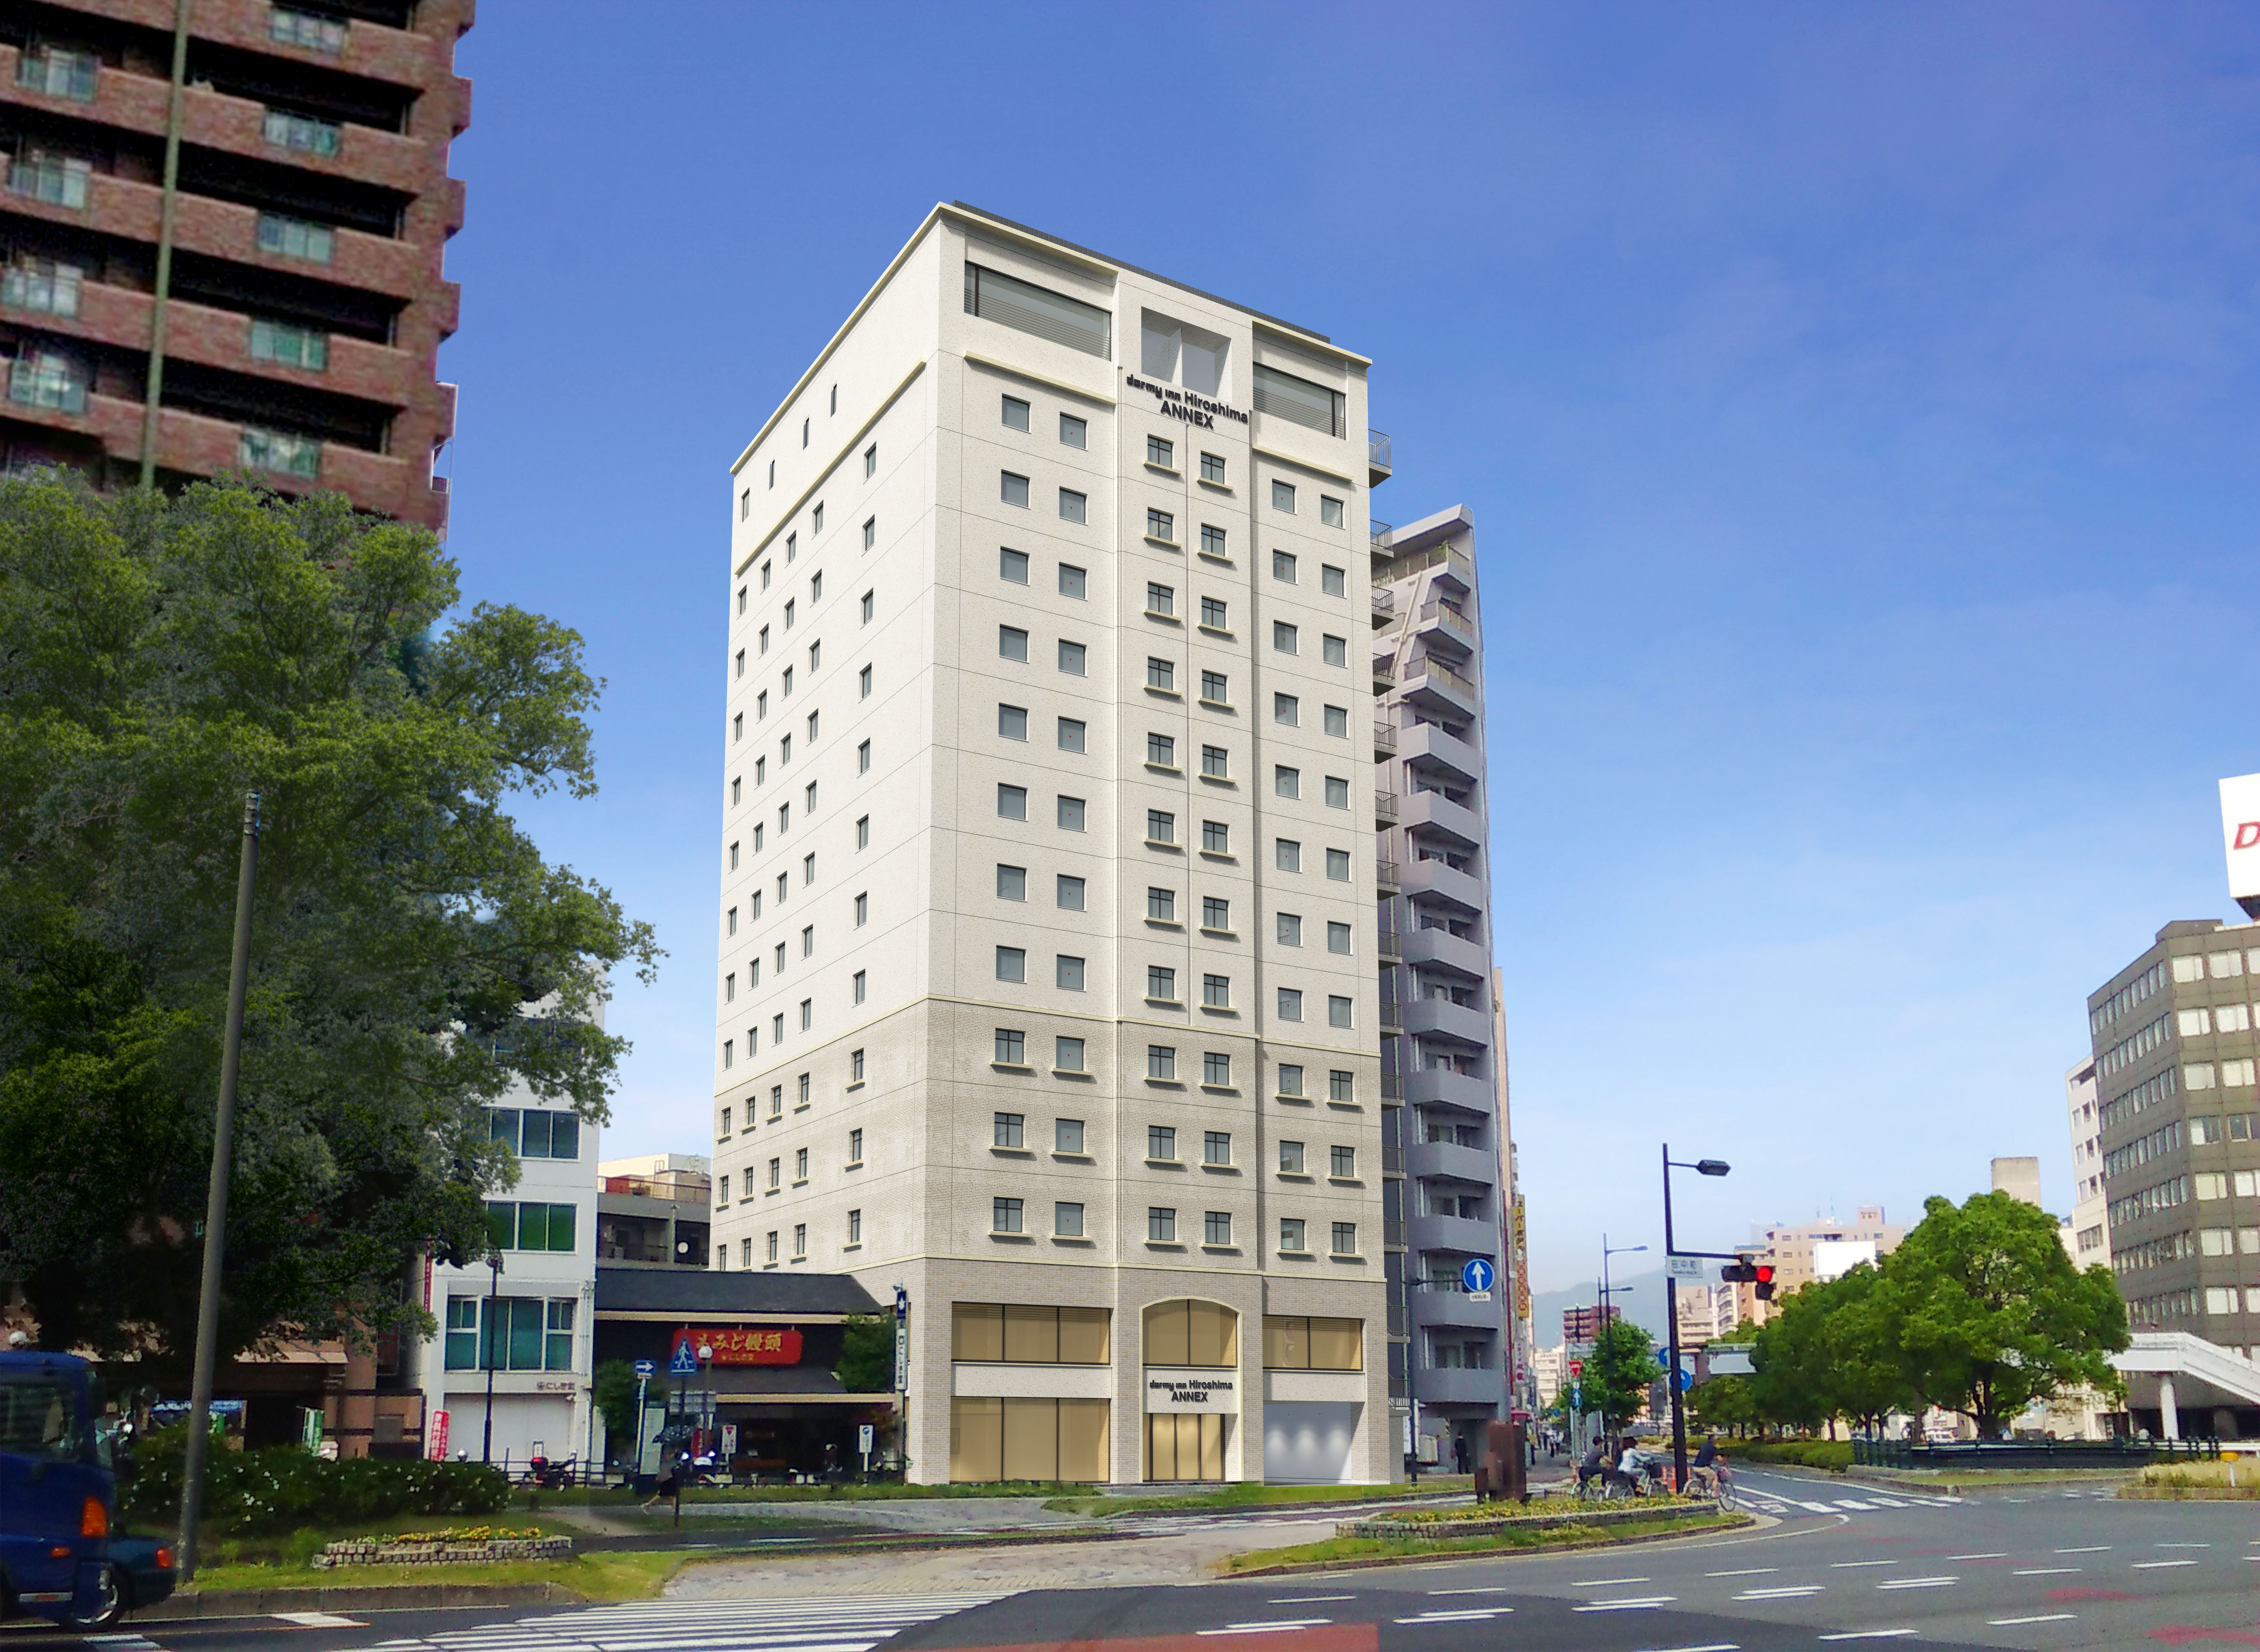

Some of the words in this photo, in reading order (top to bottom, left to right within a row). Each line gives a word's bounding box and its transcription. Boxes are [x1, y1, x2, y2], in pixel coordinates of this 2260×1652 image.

[1127, 374, 1162, 398] dormy
[1185, 391, 1248, 423] Hiroshima
[1161, 400, 1214, 429] ANNEX
[1150, 1380, 1174, 1391] dormy
[1189, 1380, 1232, 1389] Hiroshima
[1172, 1391, 1208, 1402] ANNEX
